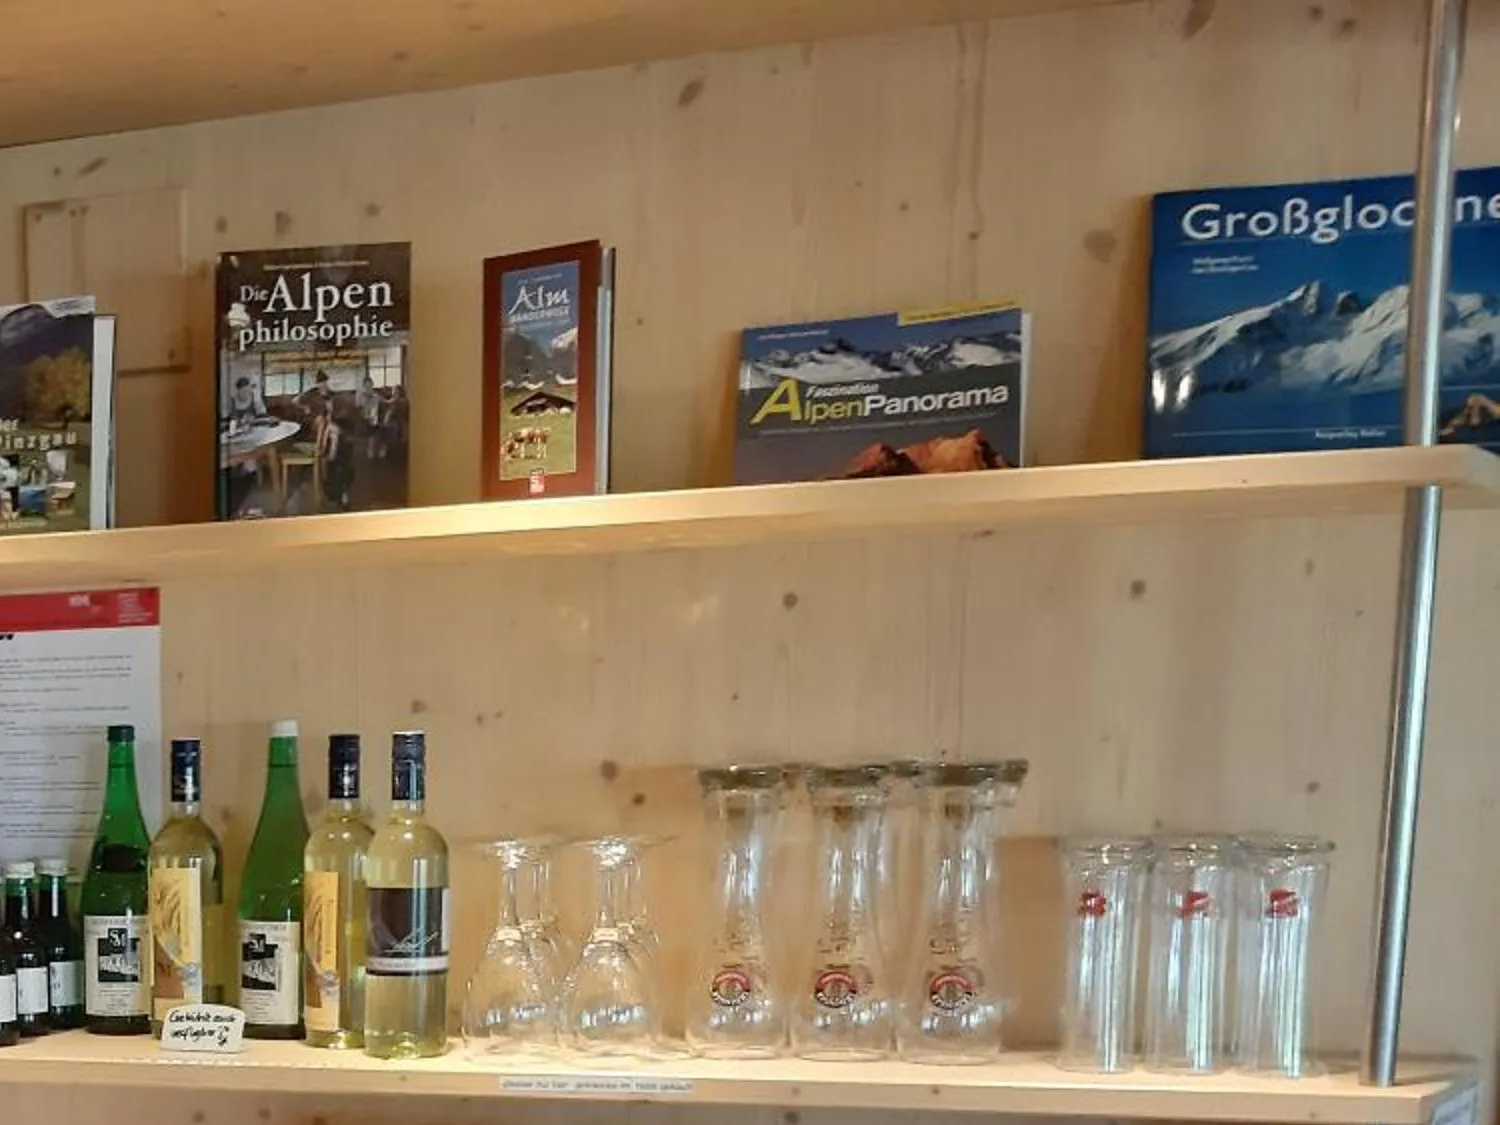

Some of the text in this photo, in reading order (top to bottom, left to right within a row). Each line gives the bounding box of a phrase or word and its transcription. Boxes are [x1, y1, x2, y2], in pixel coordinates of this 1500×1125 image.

[240, 272, 395, 326] Die Alpen
[508, 284, 572, 316] Alm
[238, 314, 395, 351] philosophie
[749, 378, 1010, 425] AlpenPanorama
